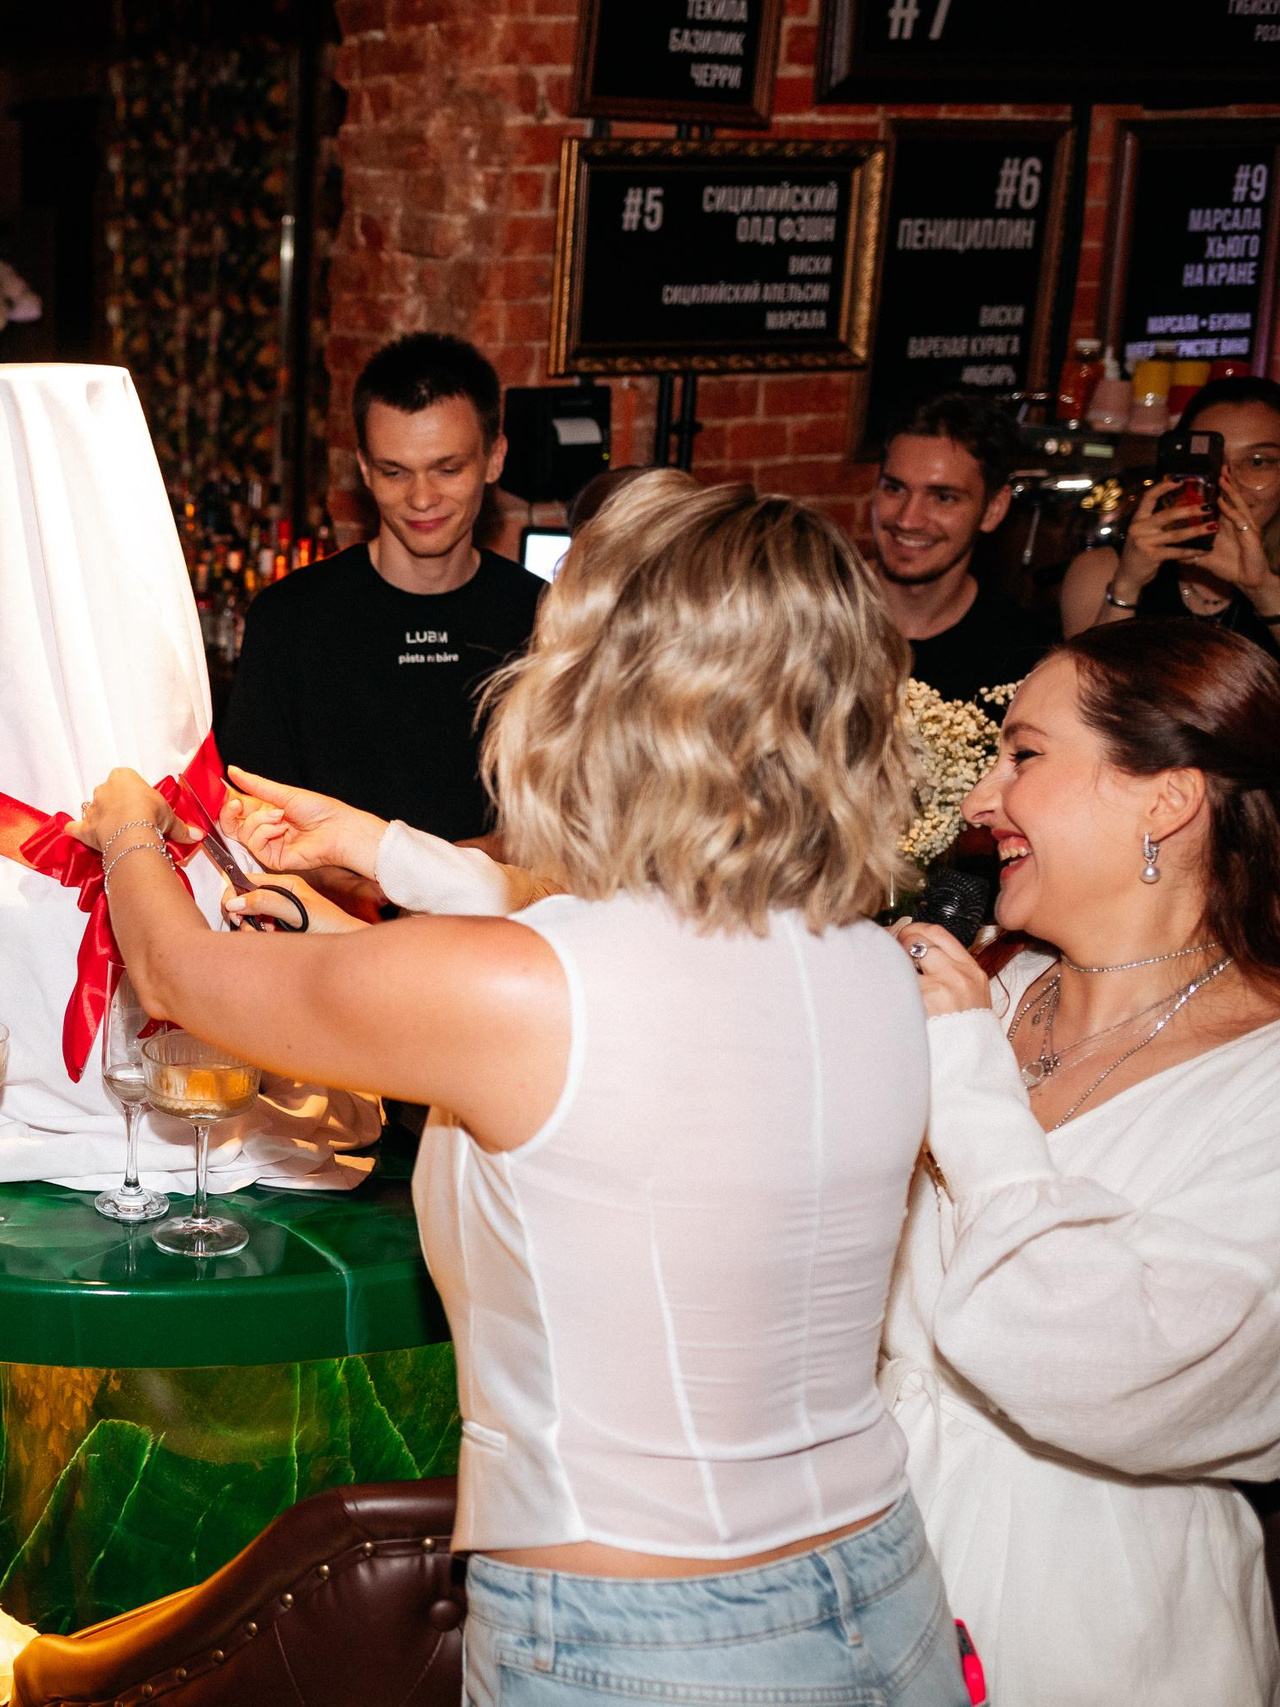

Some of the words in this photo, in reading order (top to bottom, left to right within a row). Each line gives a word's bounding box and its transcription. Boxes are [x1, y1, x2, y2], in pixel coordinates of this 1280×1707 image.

[690, 63, 743, 89] ЧЕРРИ
[702, 180, 839, 215] СИЦИЛИЙСКИЙ
[995, 156, 1042, 210] #6
[1232, 163, 1268, 203] #9
[622, 187, 664, 232] #5
[1187, 207, 1262, 232] МАРСАЛА
[736, 216, 776, 245] ОЛД
[779, 216, 837, 243] ФЭШН
[896, 217, 1036, 253] ПЕНИЦИЛЛИН
[788, 255, 832, 276] ВИСКИ
[1183, 263, 1206, 288] НА
[1207, 262, 1258, 286] КРАНЕ
